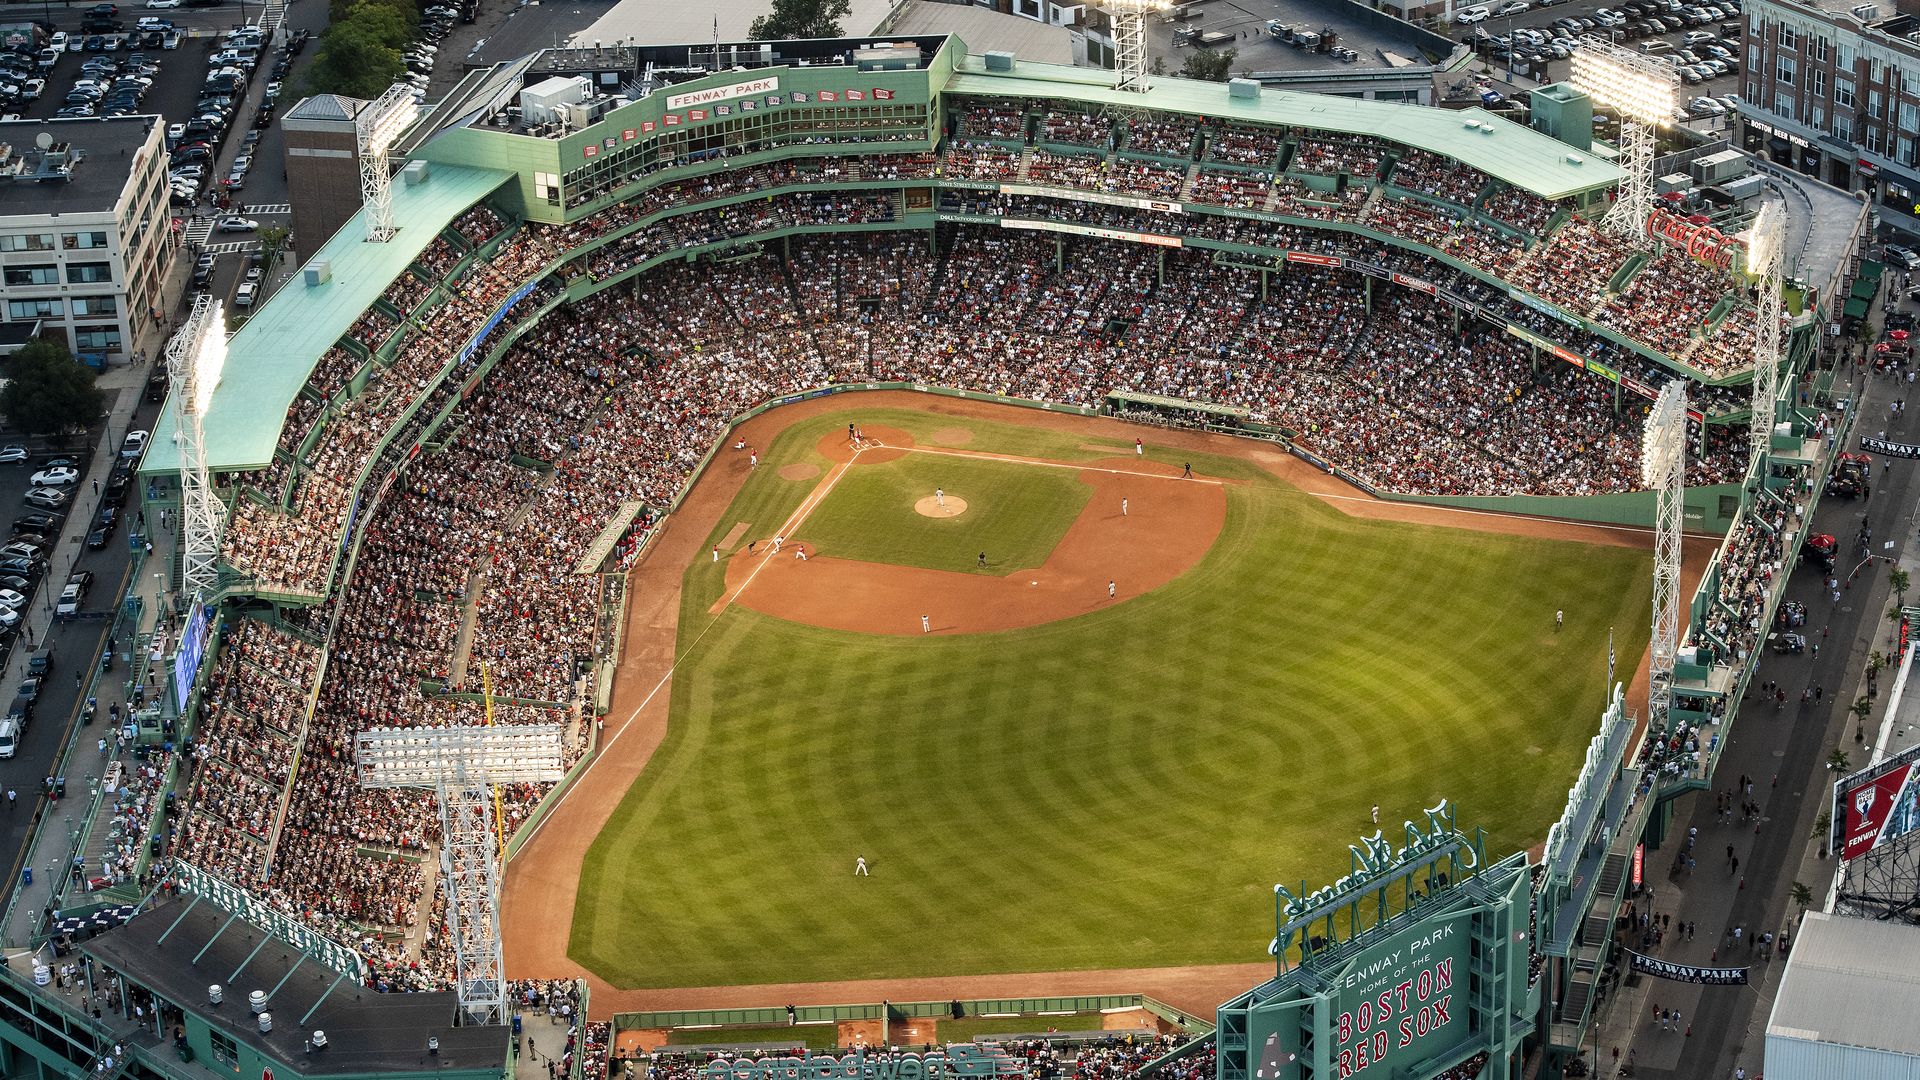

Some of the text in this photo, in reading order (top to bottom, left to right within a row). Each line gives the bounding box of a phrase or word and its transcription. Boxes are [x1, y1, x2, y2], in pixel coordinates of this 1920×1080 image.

[674, 88, 728, 106] FENWAY
[736, 80, 772, 94] PARK
[1751, 120, 1808, 148] BOSTON BEER WORKS
[1256, 214, 1280, 222] PAVILION
[1399, 276, 1432, 292] COGMEDIX
[1862, 437, 1914, 454] FENWAY
[1858, 787, 1874, 800] HOME
[1858, 794, 1872, 804] BASE
[1848, 828, 1878, 848] FENWAY
[1410, 922, 1454, 954] PARK
[1360, 954, 1431, 996] HOME OF THE
[1631, 962, 1690, 982] LANSDOWNE
[1636, 956, 1742, 978] FENWAY PARK
[1338, 956, 1454, 1046] BOSTON
[1338, 995, 1452, 1080] RED SOX
